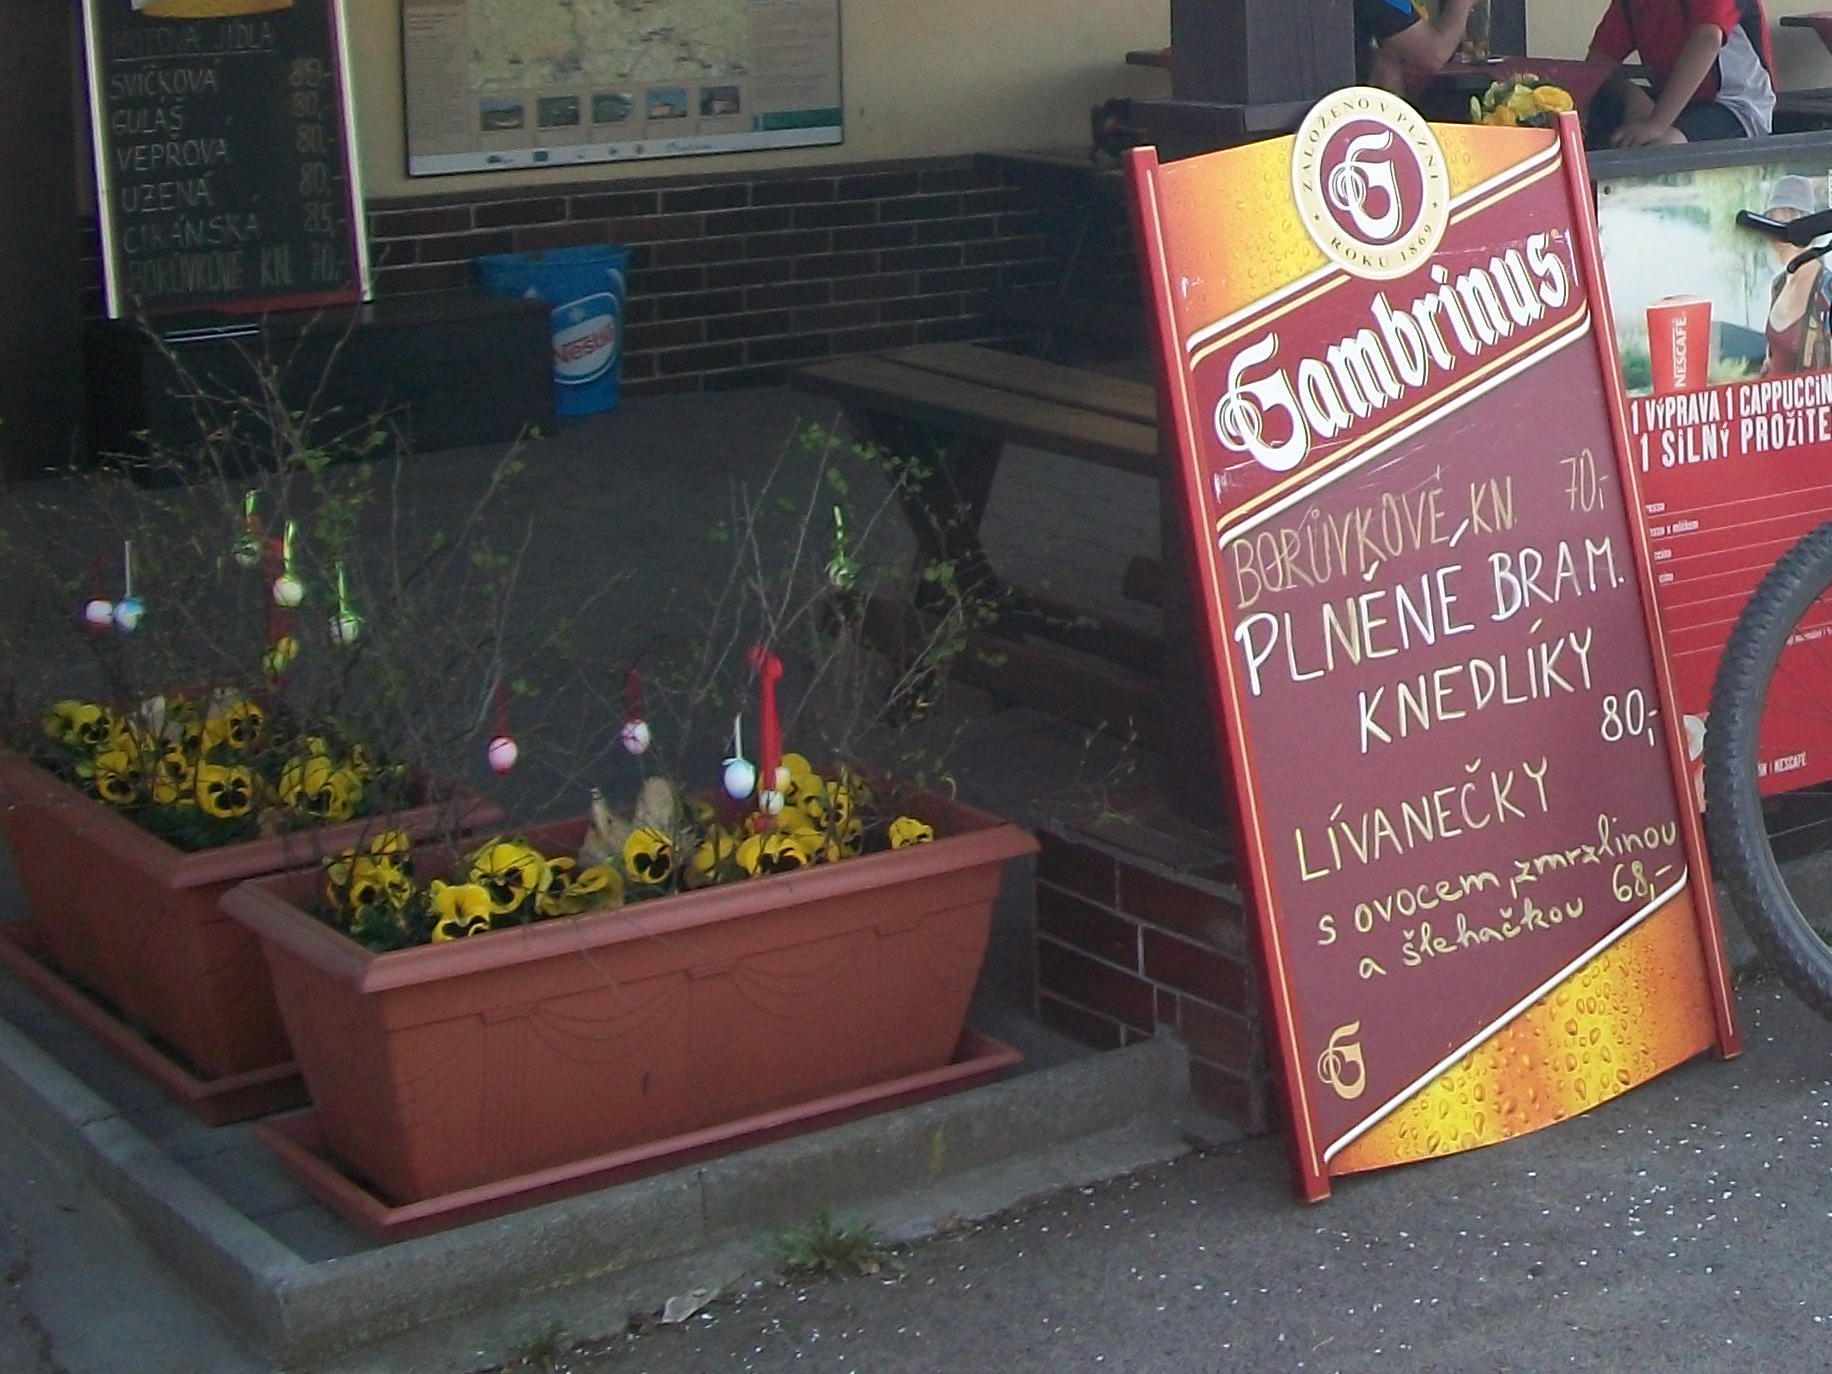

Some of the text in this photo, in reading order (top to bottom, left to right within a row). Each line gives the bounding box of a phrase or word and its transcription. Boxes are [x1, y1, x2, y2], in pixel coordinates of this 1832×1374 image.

[1213, 231, 1570, 473] Gambrinus
[1672, 311, 1688, 390] NESCAFÉ
[1630, 400, 1639, 435] 1
[1725, 386, 1734, 421] 1
[1640, 433, 1649, 473] 1
[1488, 536, 1626, 622] BRAM.
[1358, 617, 1593, 754] KNEDLÍKY
[1295, 756, 1549, 882] LÍVANEČKY
[1354, 870, 1500, 933] ovocem
[1358, 957, 1388, 979] a
[1402, 895, 1585, 967] šlehačkou
